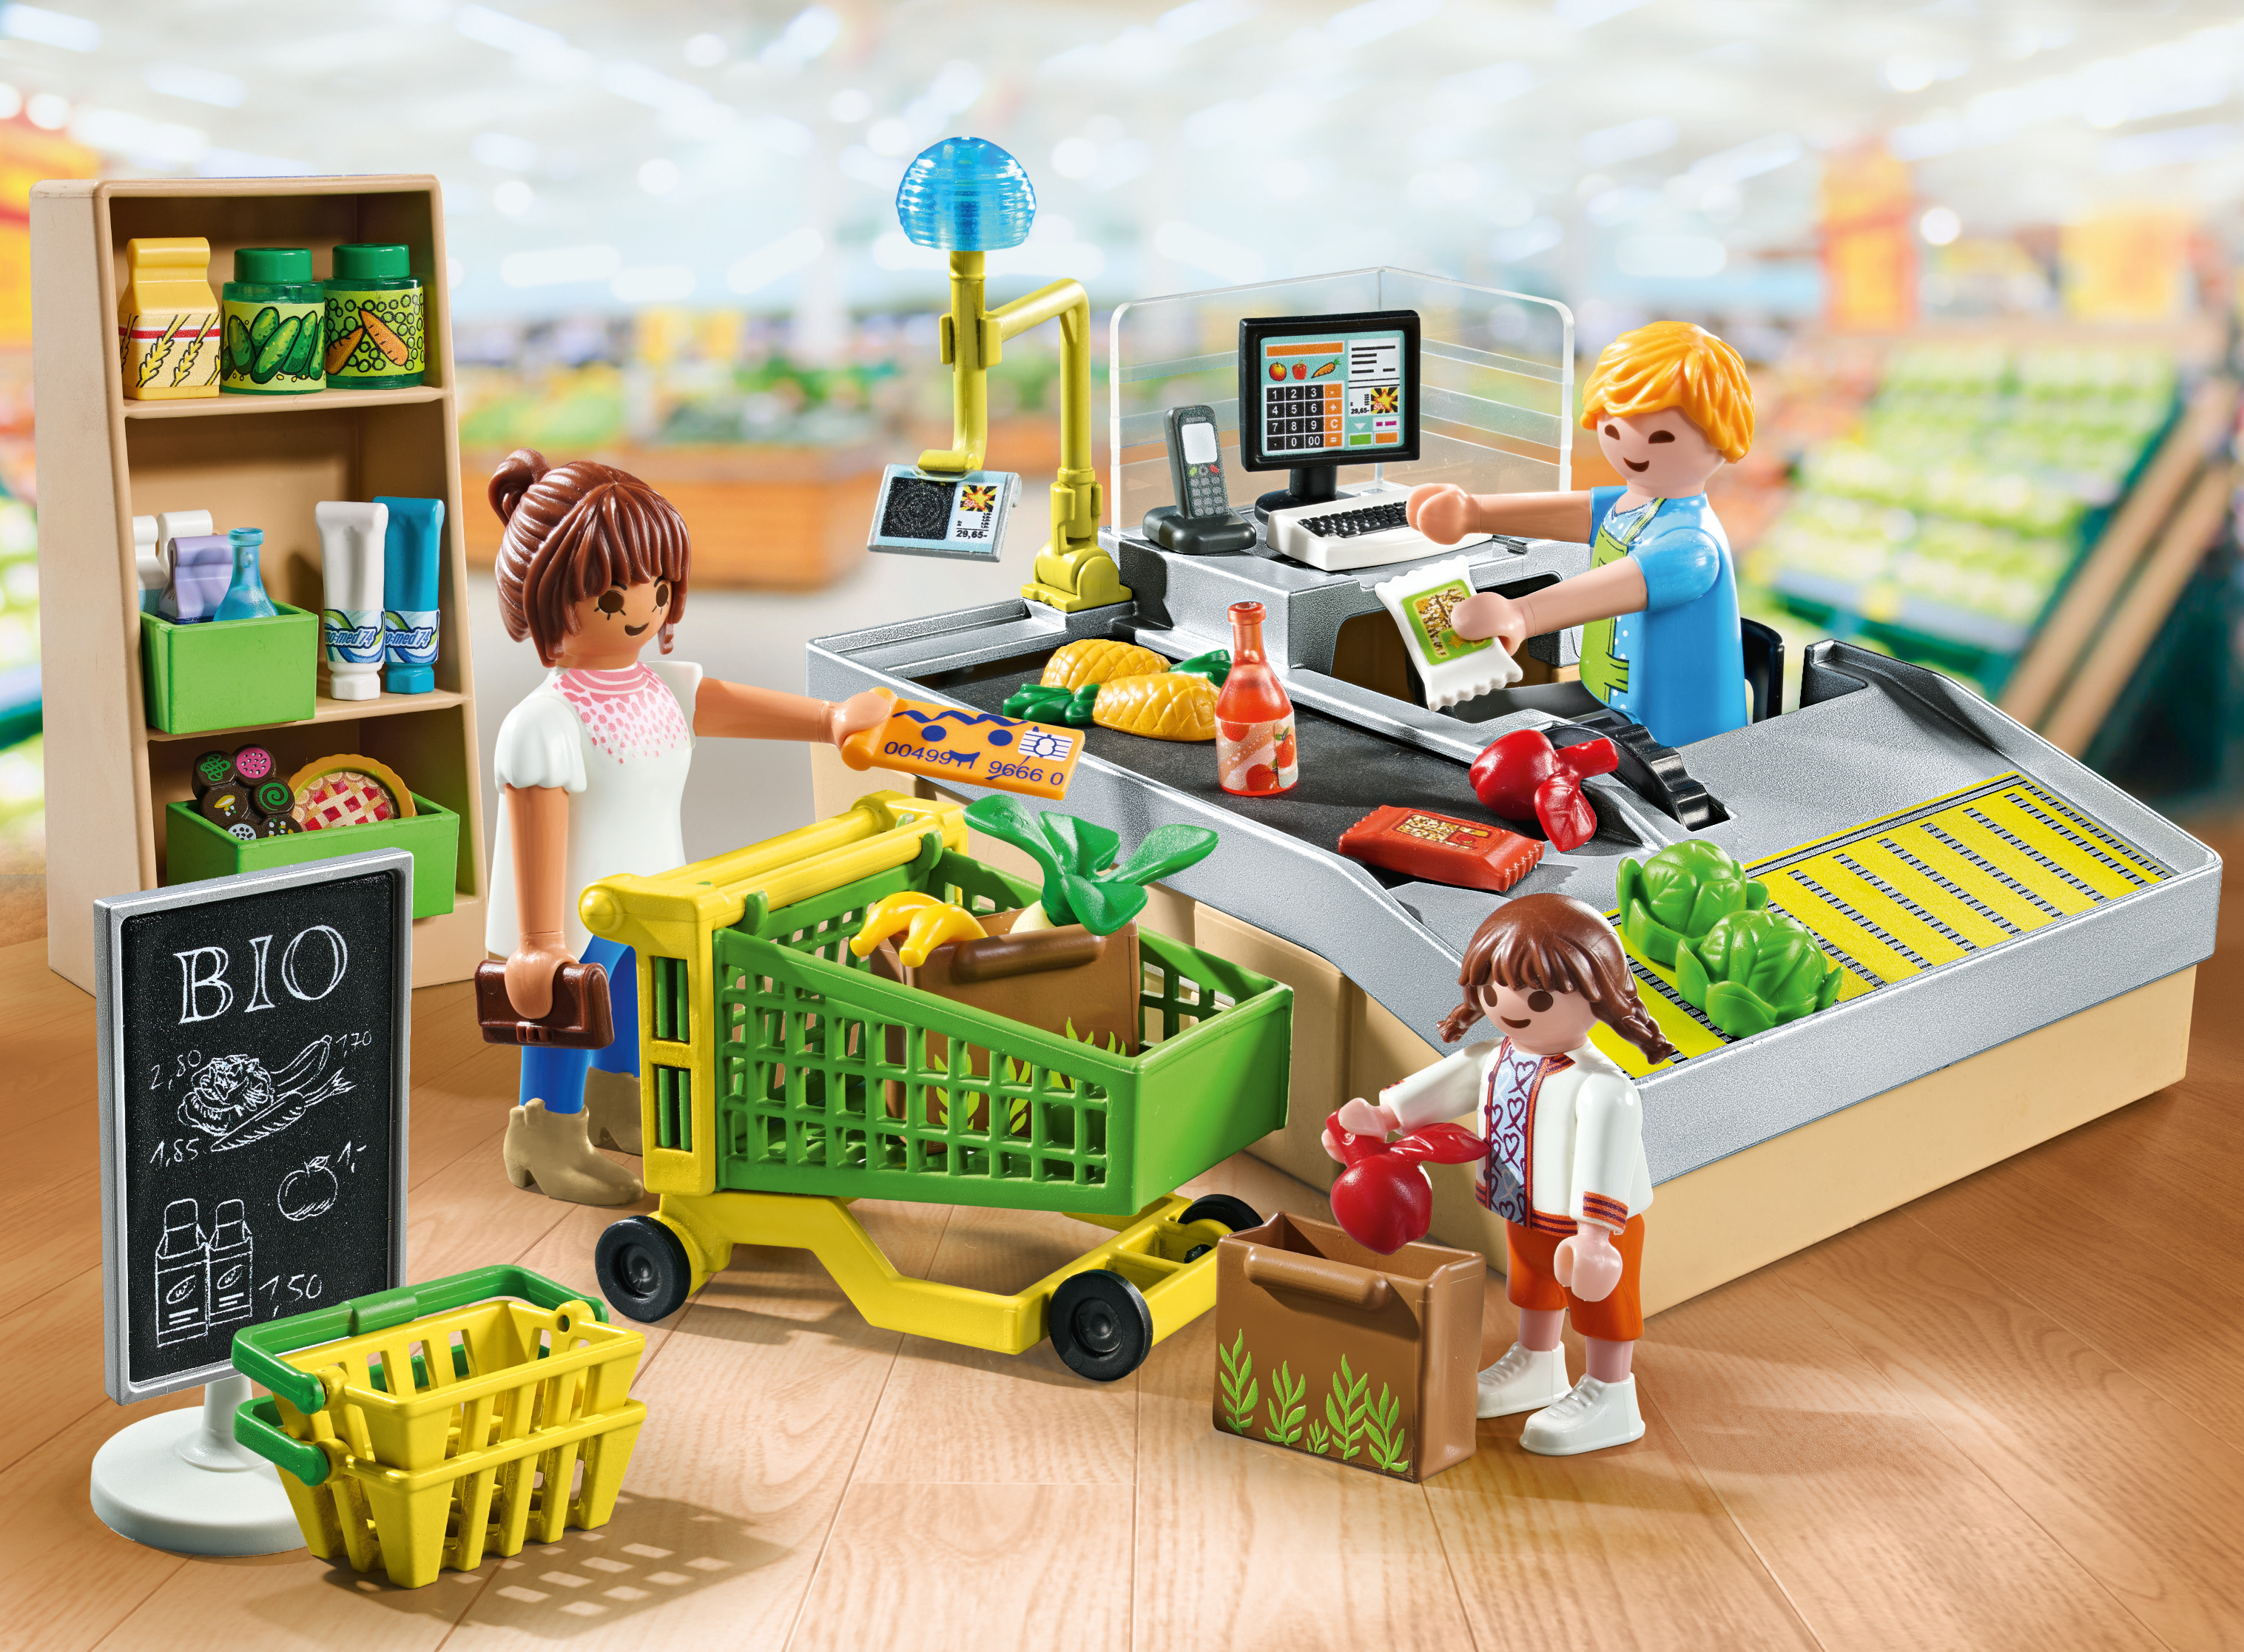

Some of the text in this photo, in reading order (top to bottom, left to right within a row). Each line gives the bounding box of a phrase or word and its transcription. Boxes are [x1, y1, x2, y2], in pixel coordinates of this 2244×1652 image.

[1272, 390, 1277, 399] 1
[1290, 388, 1298, 399] 2
[1310, 388, 1317, 397] 3
[1272, 405, 1278, 415] 4
[1291, 405, 1298, 414] 5
[1310, 403, 1317, 413] 6
[1272, 422, 1278, 432] 7
[1291, 421, 1297, 431] 8
[1310, 420, 1317, 430] 9
[1330, 419, 1338, 428] C
[1291, 437, 1297, 447] 0
[1308, 436, 1321, 445] 00
[358, 630, 374, 645] 74
[416, 631, 431, 645] 74
[883, 741, 1064, 786] 00499 9666 0
[173, 924, 349, 1025] BIO
[150, 1049, 202, 1091] 2,80
[149, 1138, 200, 1168] 1,85
[258, 1273, 322, 1318] 1,50
